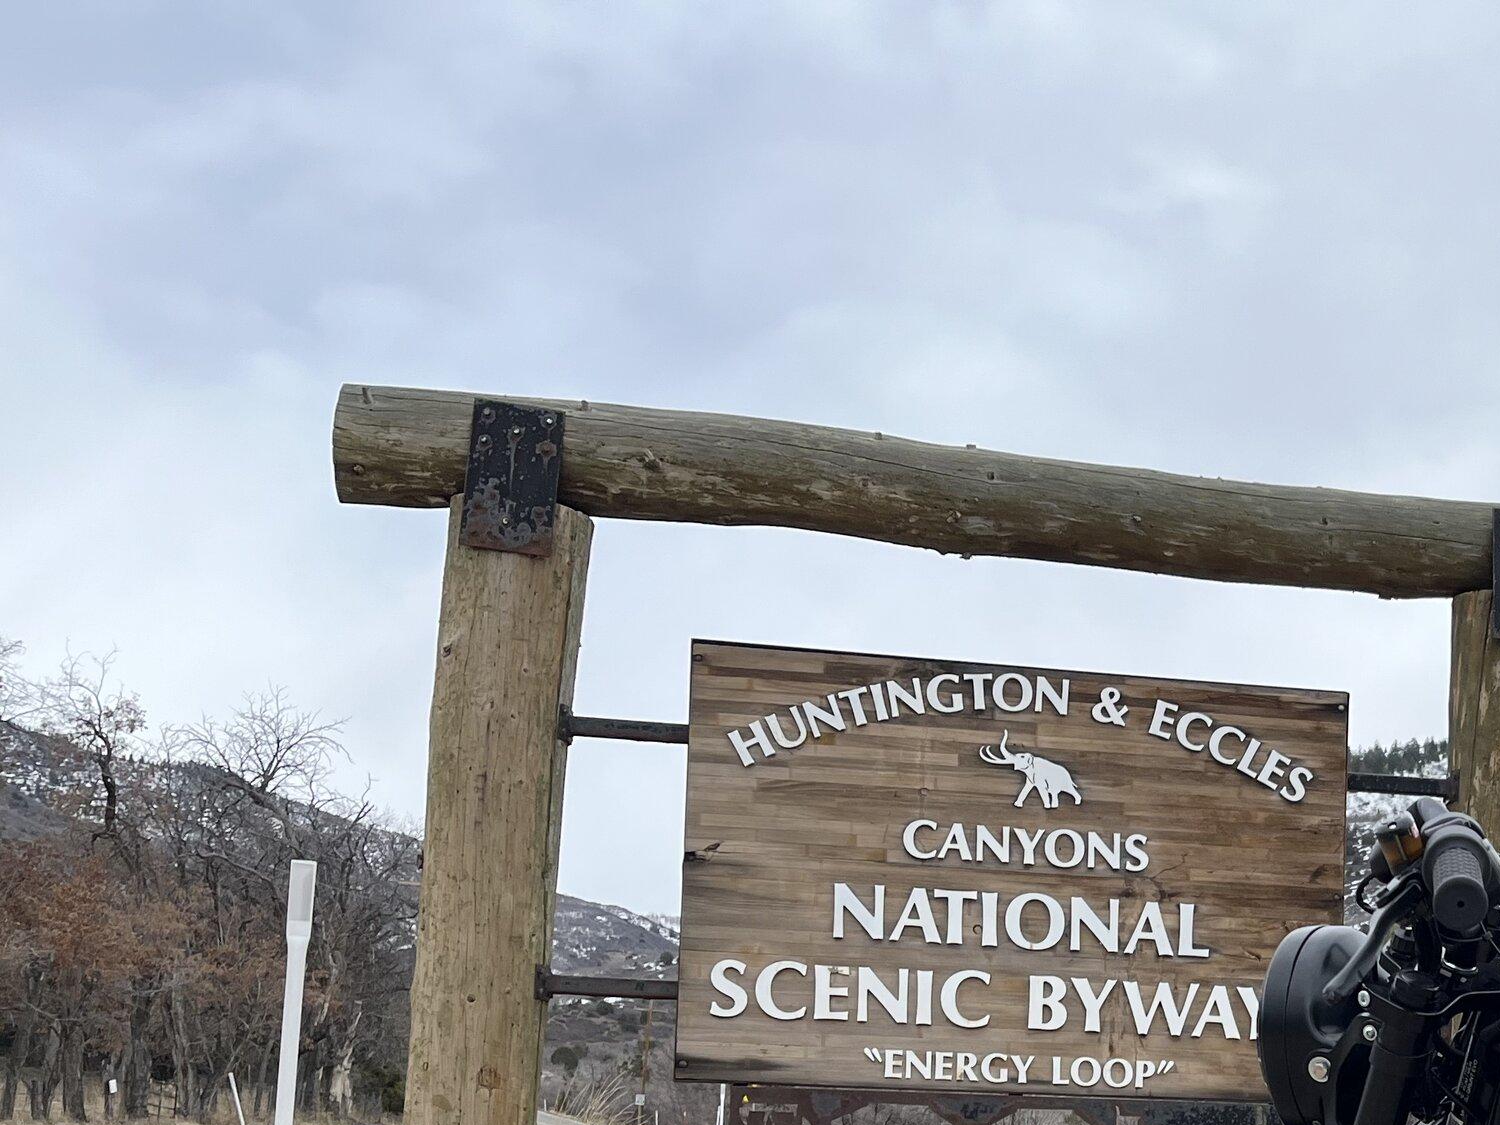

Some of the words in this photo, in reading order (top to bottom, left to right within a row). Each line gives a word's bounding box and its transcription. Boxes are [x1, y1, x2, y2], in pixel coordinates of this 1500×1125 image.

[727, 672, 1071, 768] HUNTINGTON
[1091, 686, 1129, 727] &
[1147, 699, 1315, 803] ECCLES
[902, 819, 1149, 872] CANYONS
[831, 882, 1210, 959] NATIONAL
[709, 959, 991, 1029] SCENIC
[1027, 975, 1260, 1041] BYWAY
